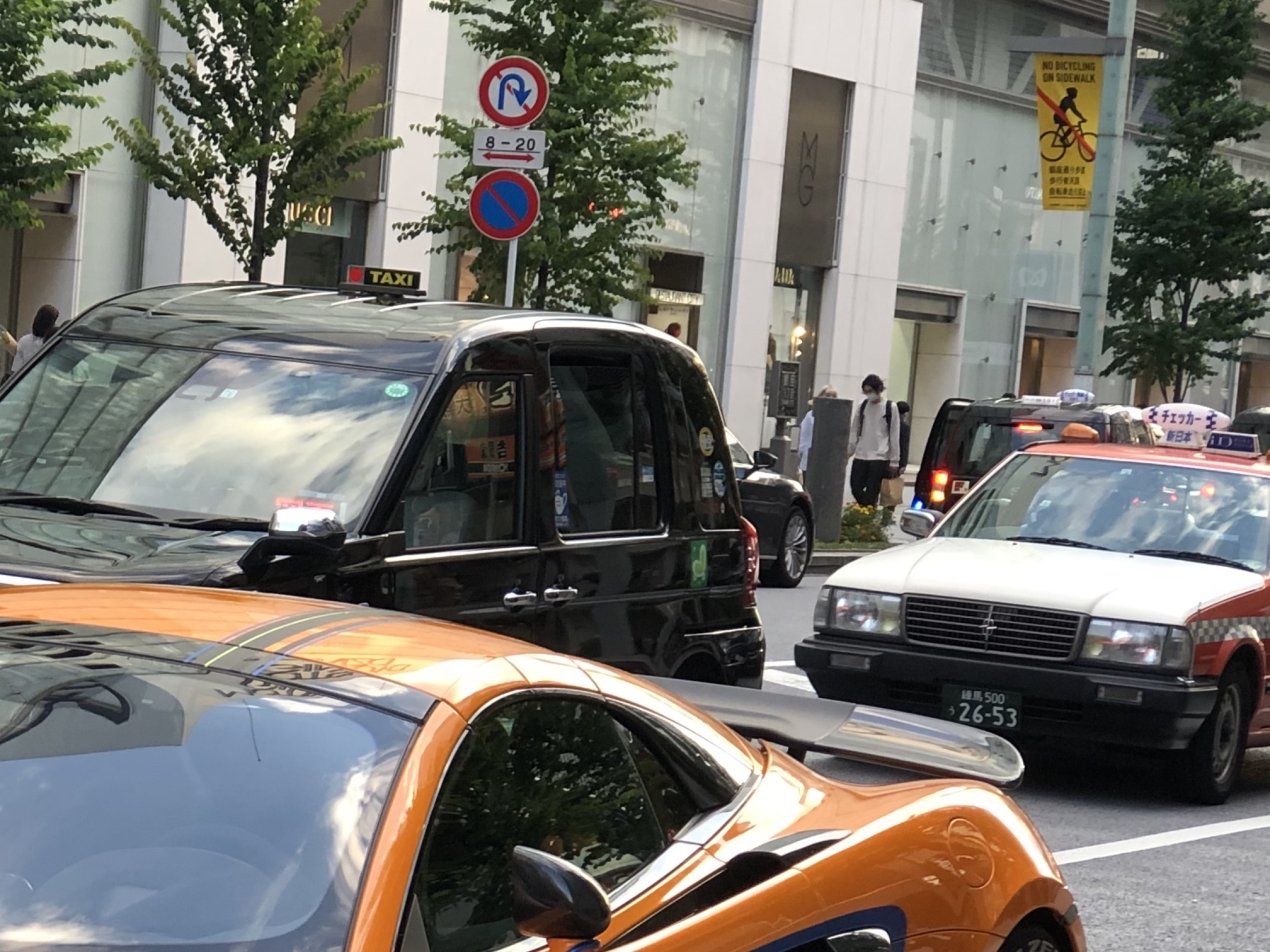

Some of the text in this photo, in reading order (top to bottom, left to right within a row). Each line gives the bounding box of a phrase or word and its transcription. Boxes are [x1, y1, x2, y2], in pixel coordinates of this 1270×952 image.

[1042, 61, 1096, 72] NO BICYCLING
[1042, 73, 1096, 83] ON SIDEWALK
[370, 270, 414, 287] TAXI
[1161, 410, 1202, 425] チェッカー
[1166, 430, 1192, 443] 新日本
[959, 702, 1018, 727] 26-53
